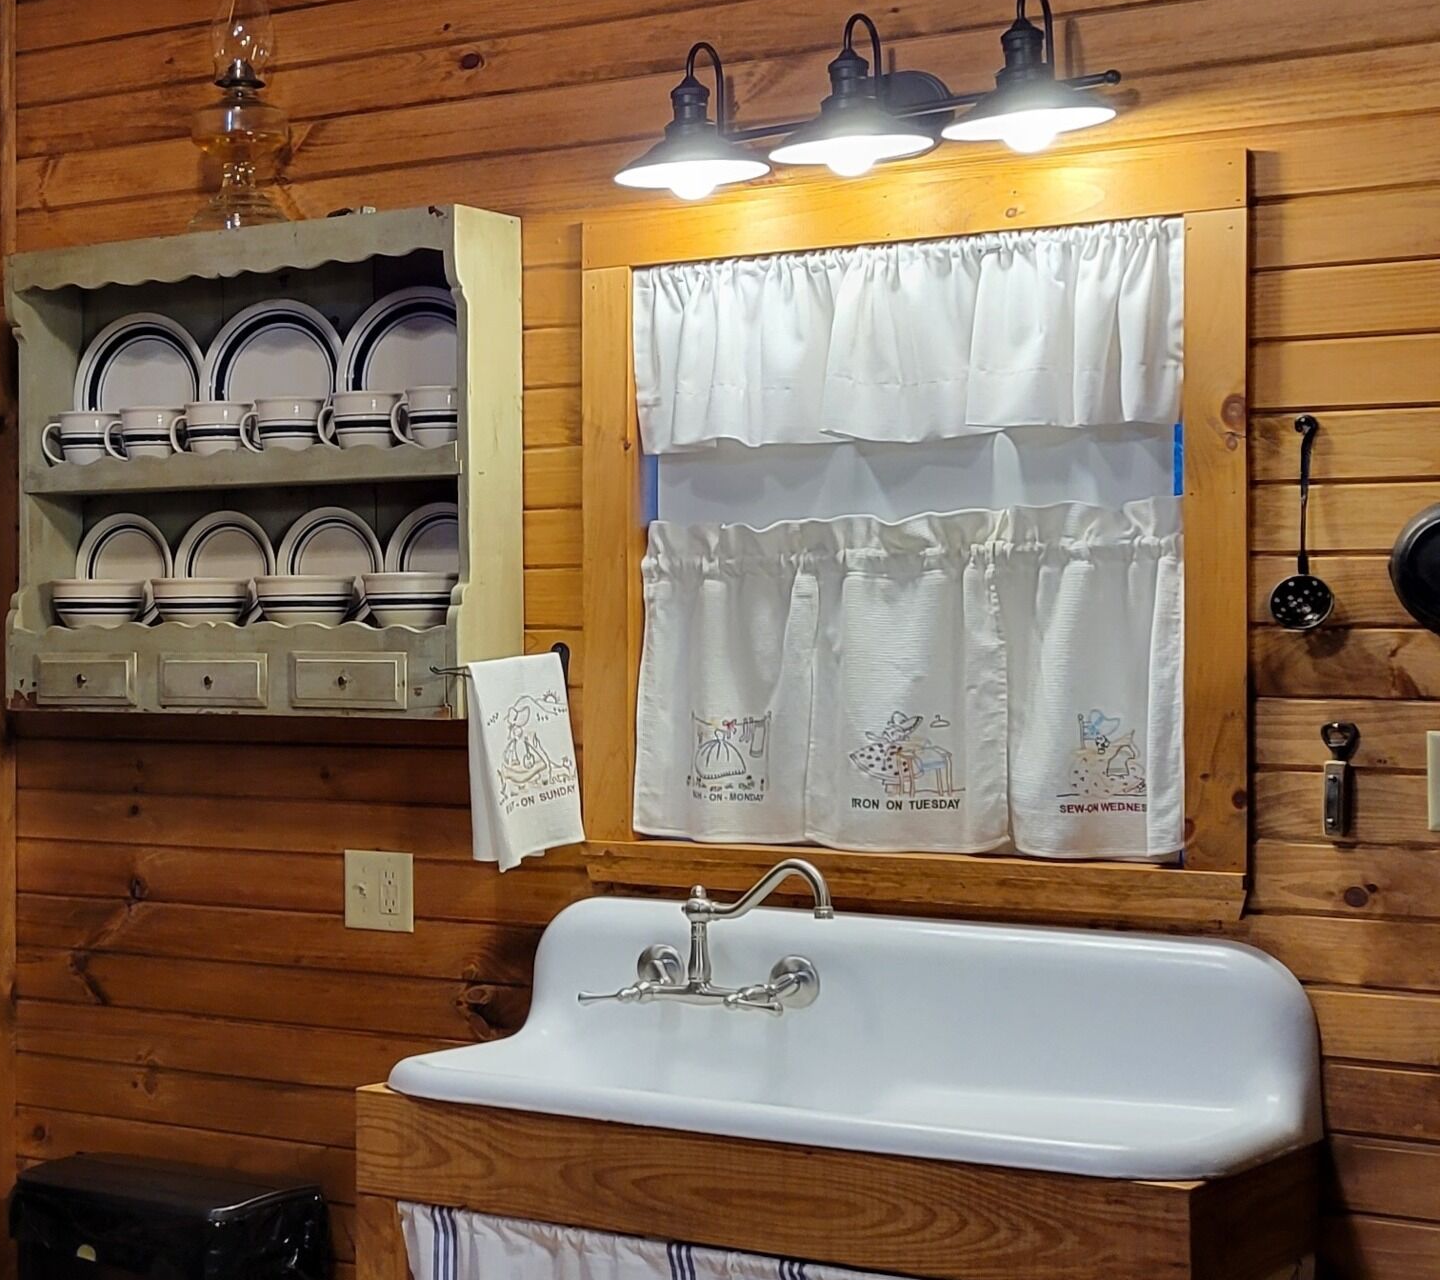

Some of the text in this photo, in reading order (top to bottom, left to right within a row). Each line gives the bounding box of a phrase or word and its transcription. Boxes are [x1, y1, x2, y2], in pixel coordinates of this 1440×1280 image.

[539, 784, 575, 802] SUNDAY
[851, 798, 961, 810] IRON ON TUESDAY
